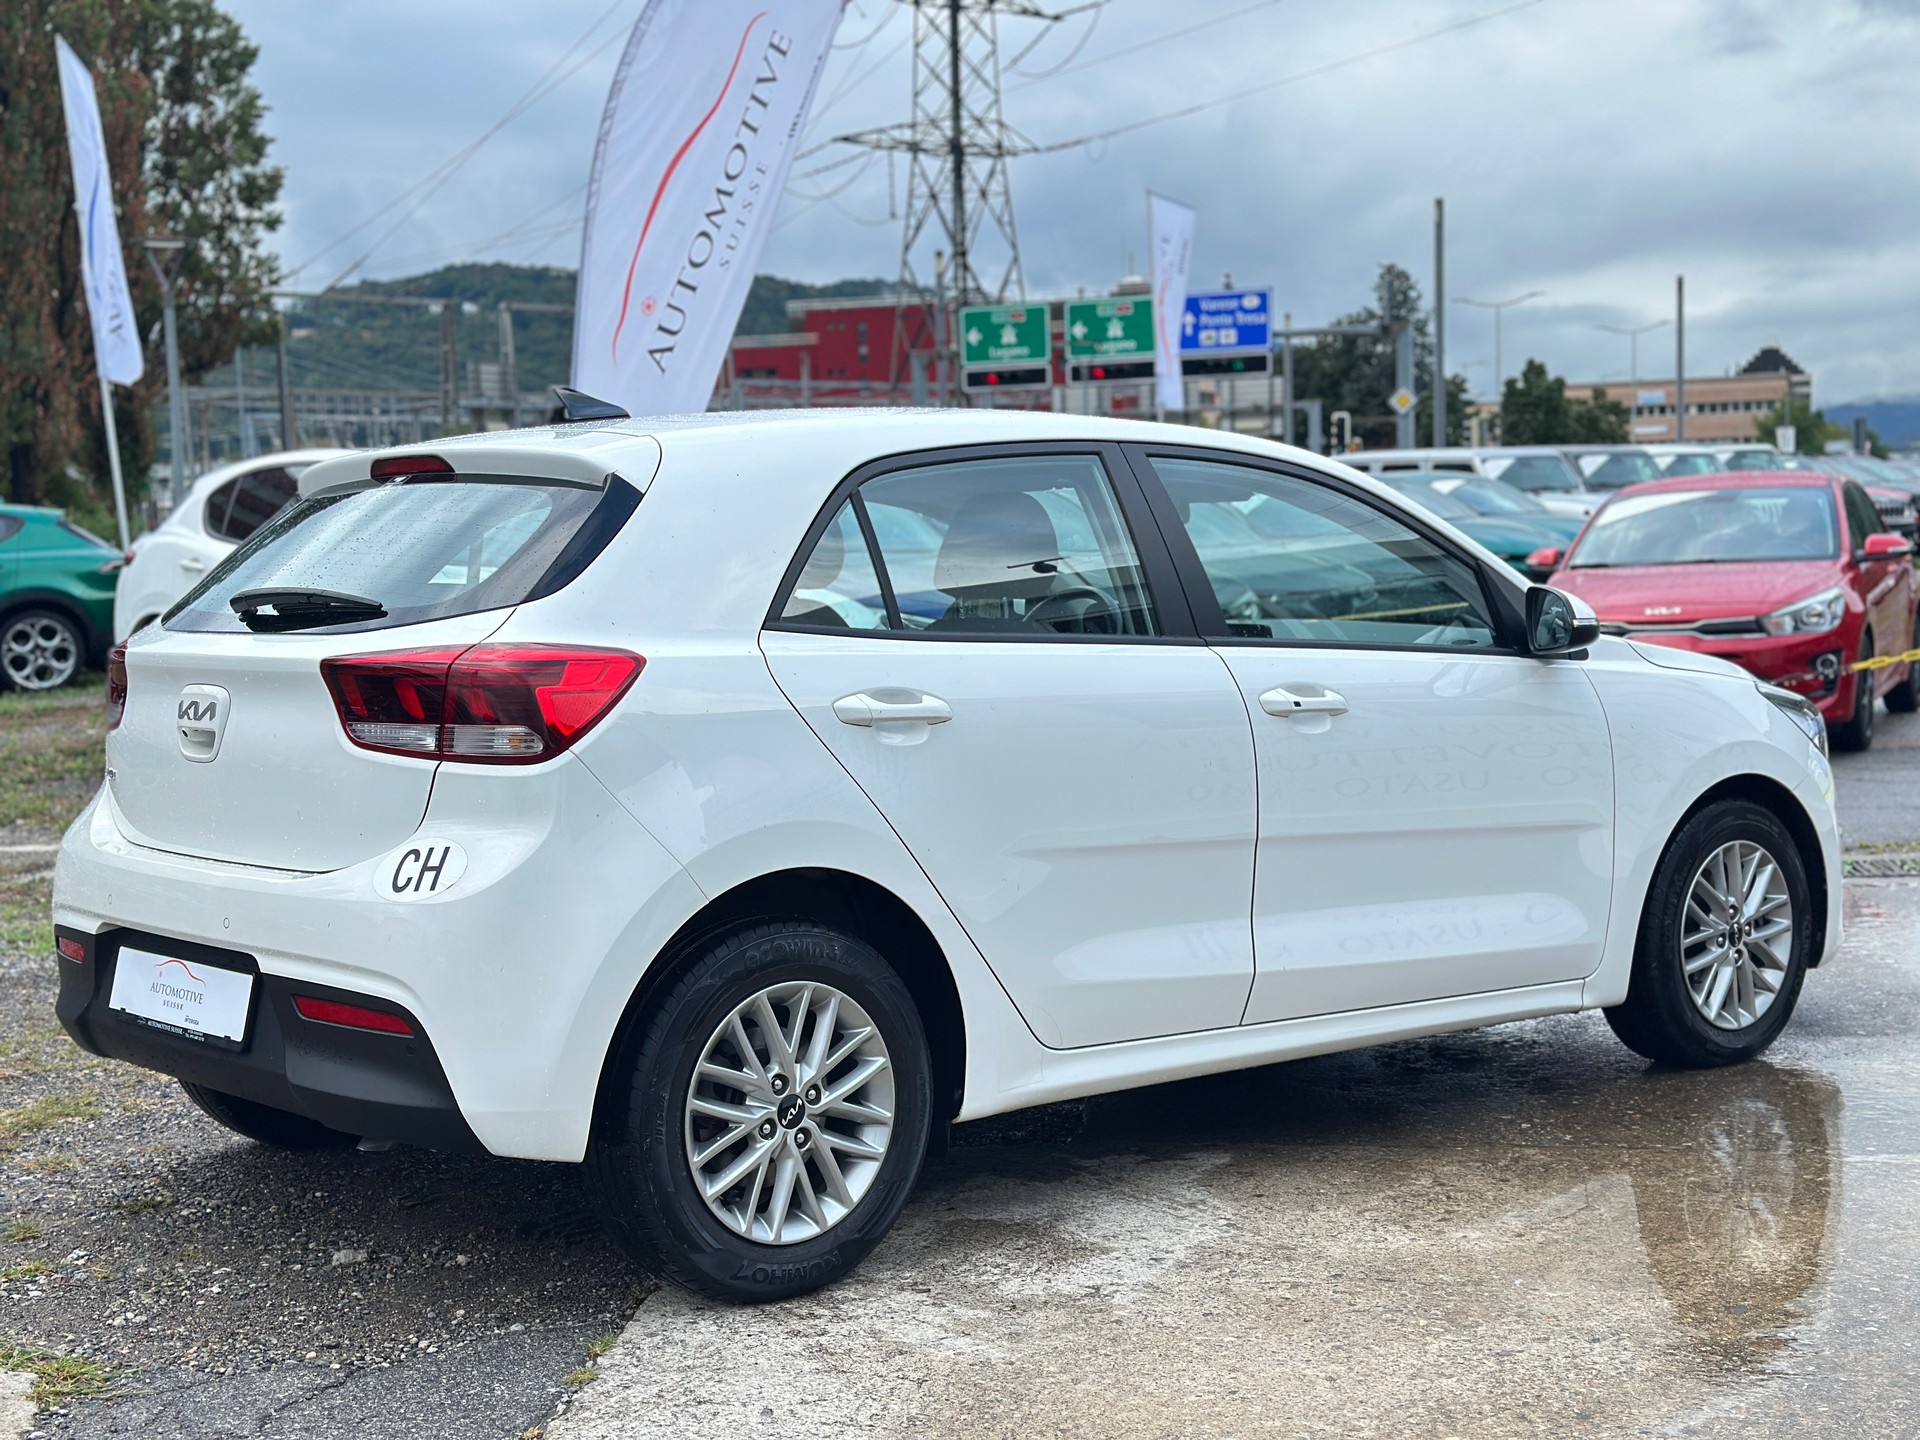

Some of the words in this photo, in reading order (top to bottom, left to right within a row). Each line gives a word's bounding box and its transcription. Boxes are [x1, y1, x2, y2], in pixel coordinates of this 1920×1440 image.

[647, 29, 792, 374] AUTOMOTIVE
[719, 161, 769, 271] SUISSE
[178, 700, 217, 721] KIA
[392, 846, 450, 893] CH
[150, 981, 205, 1005] AUTOMOTIVE
[163, 1000, 184, 1011] SUISSE
[781, 1098, 803, 1126] KIA
